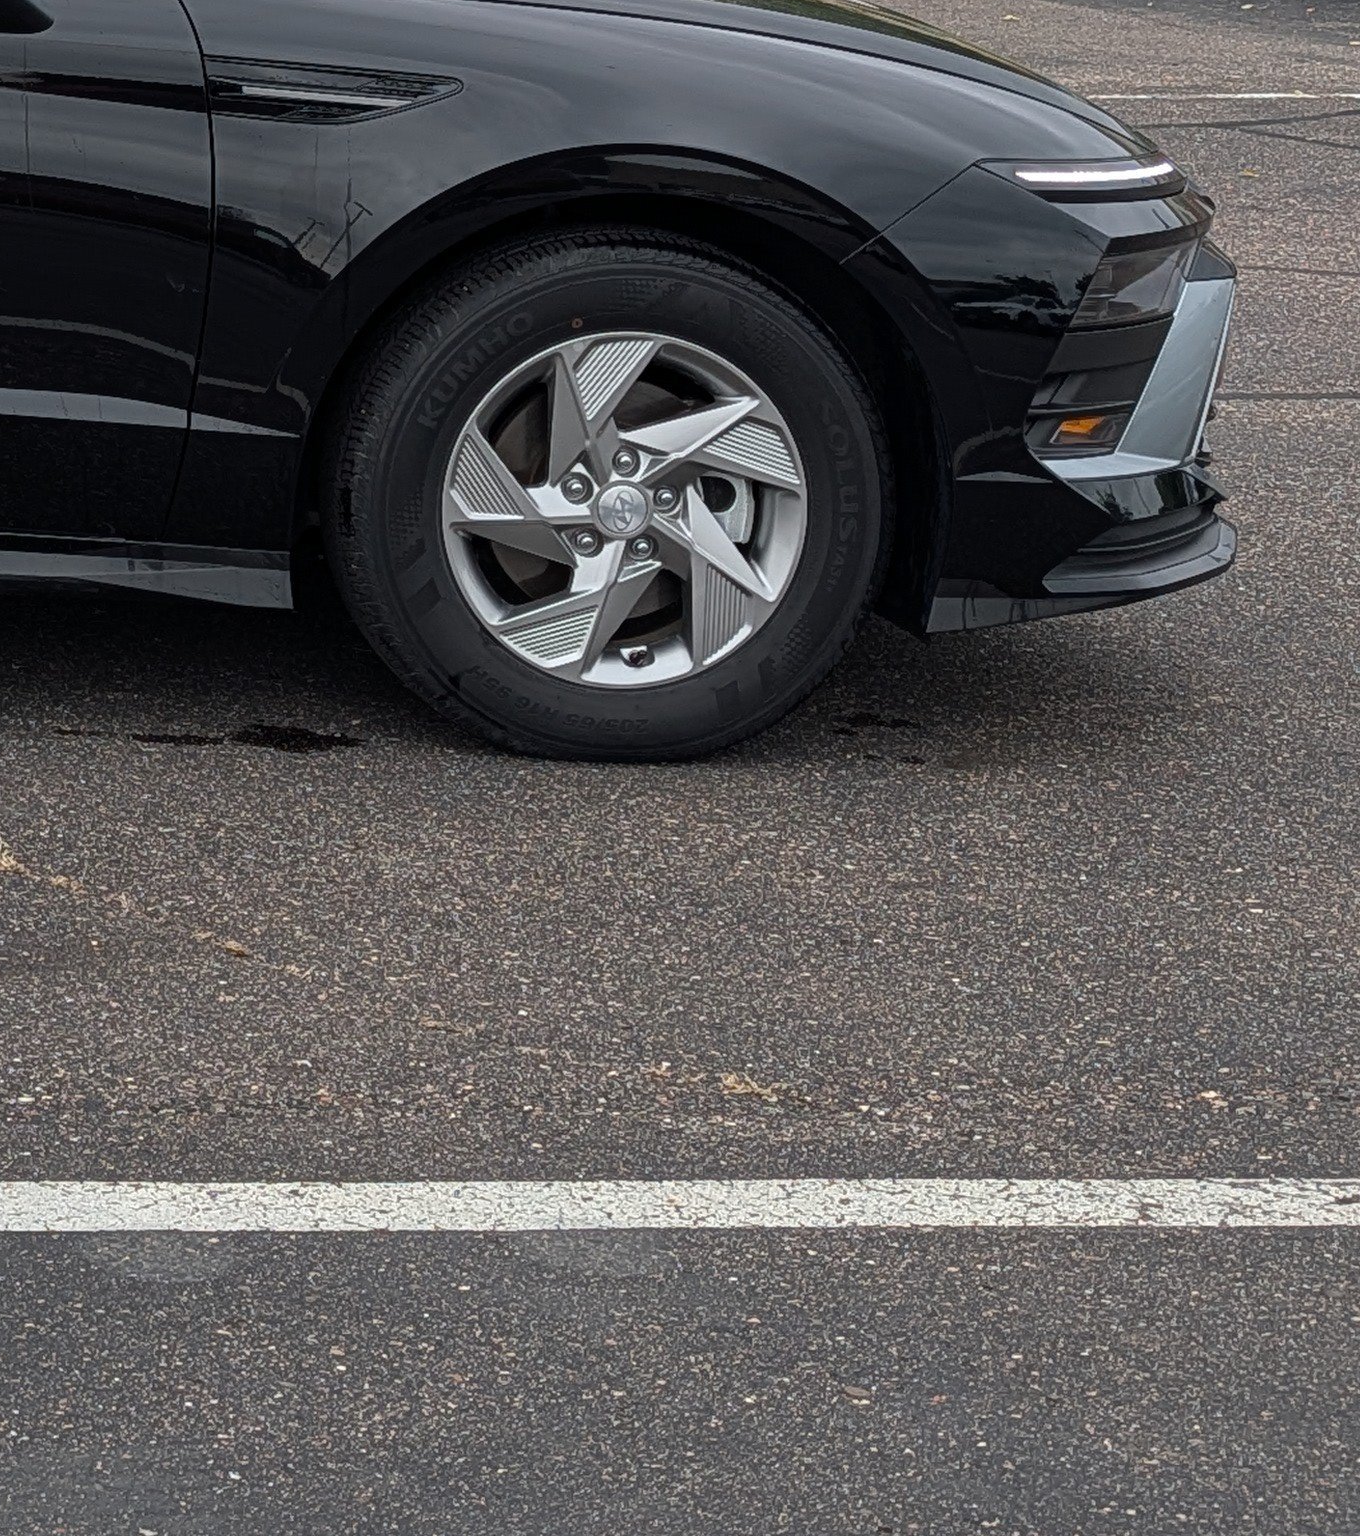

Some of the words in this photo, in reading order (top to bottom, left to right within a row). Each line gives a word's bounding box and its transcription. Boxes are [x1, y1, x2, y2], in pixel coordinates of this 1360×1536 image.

[417, 311, 534, 431] KUMHO
[821, 399, 859, 542] SOLUS
[561, 713, 650, 735] 205/65
